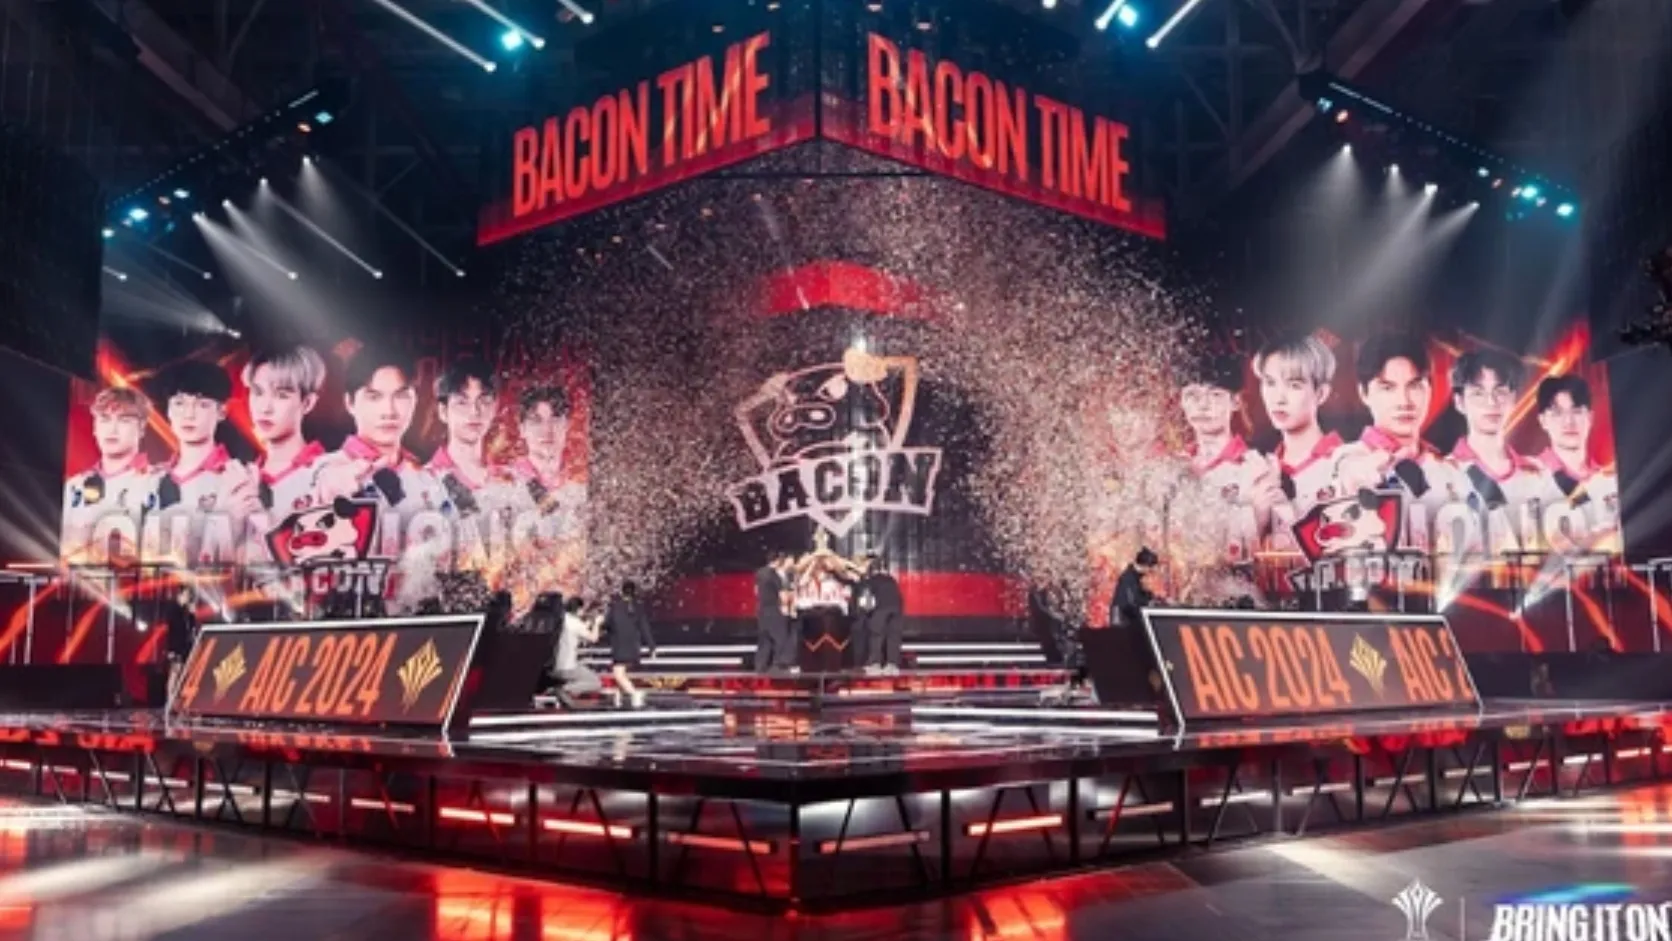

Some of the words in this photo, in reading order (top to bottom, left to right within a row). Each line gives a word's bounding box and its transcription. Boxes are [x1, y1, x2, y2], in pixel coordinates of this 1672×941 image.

[513, 84, 649, 218] BACON
[657, 32, 771, 159] TIME
[868, 33, 1027, 182] BACON
[1034, 94, 1131, 211] TIME
[738, 452, 936, 521] BACON
[238, 635, 310, 713] AIC
[294, 632, 398, 717] 2024
[1178, 625, 1258, 711] AIC
[1248, 626, 1351, 706] 2024
[1387, 625, 1454, 702] AIC
